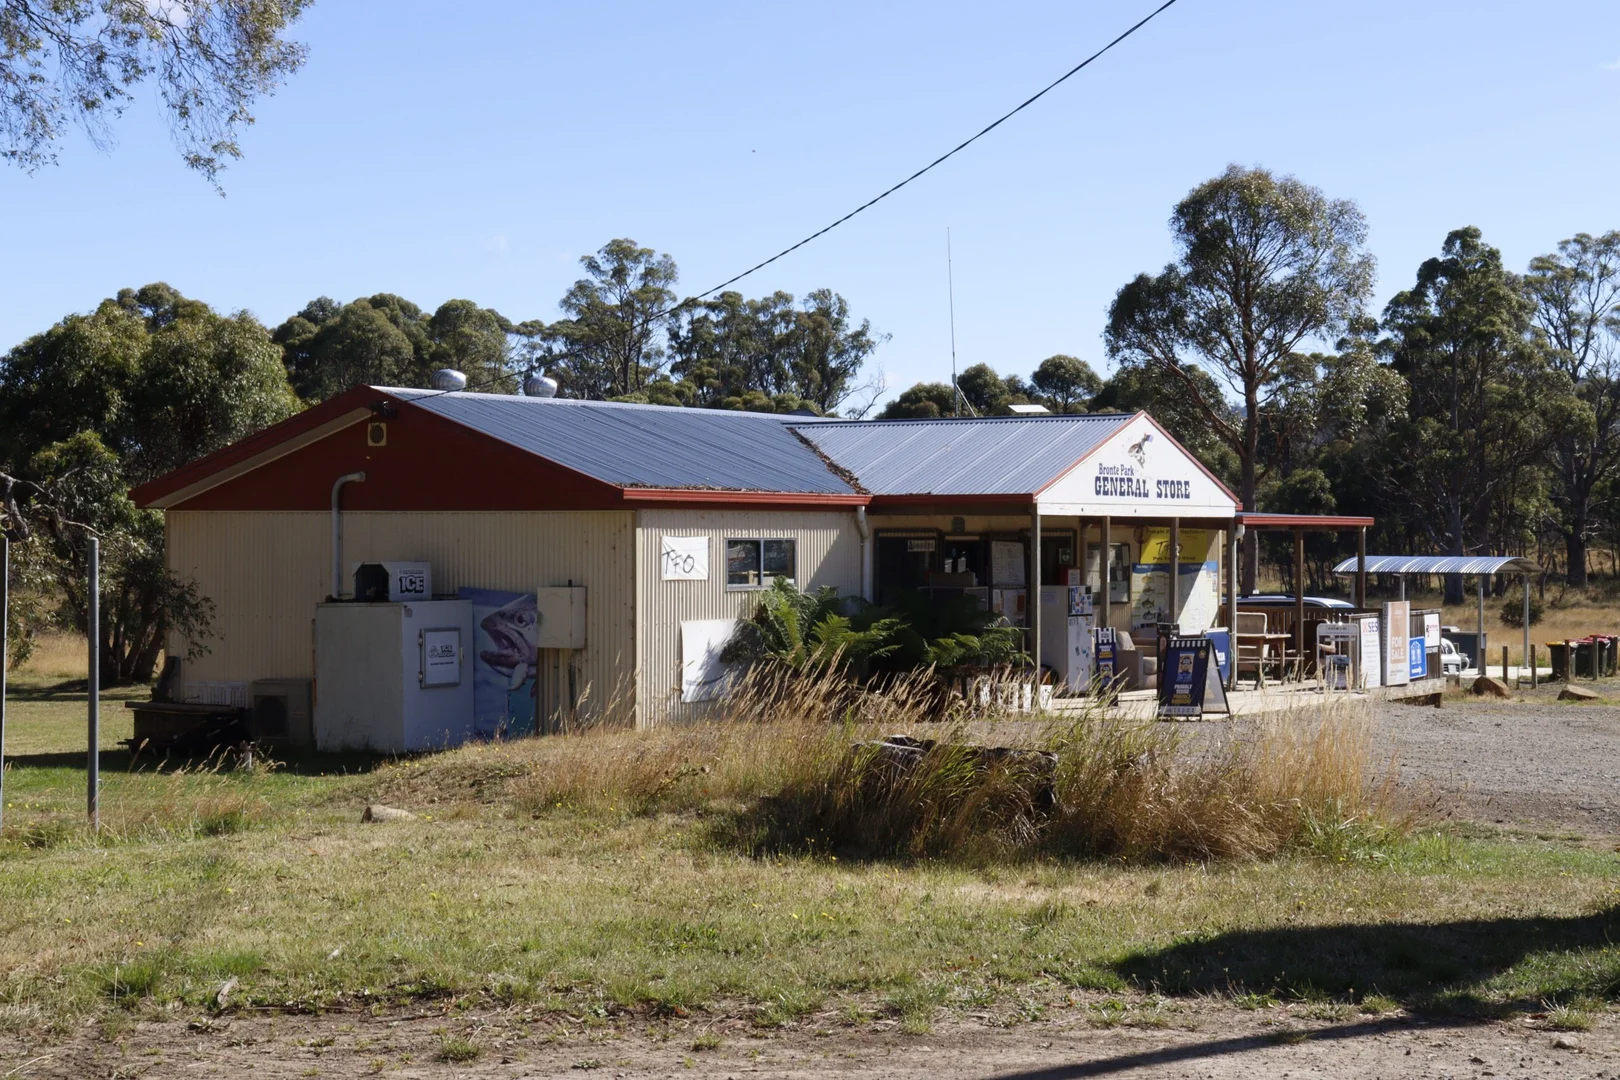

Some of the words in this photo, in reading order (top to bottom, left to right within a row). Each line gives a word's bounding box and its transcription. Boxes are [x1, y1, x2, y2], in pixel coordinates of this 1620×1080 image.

[1098, 463, 1120, 476] Bronte
[1120, 464, 1135, 477] Park
[1094, 476, 1149, 498] GENERAL
[1156, 479, 1191, 499] STORE
[399, 574, 425, 594] ICE
[1391, 636, 1402, 648] FOR
[1391, 648, 1404, 660] SALE
